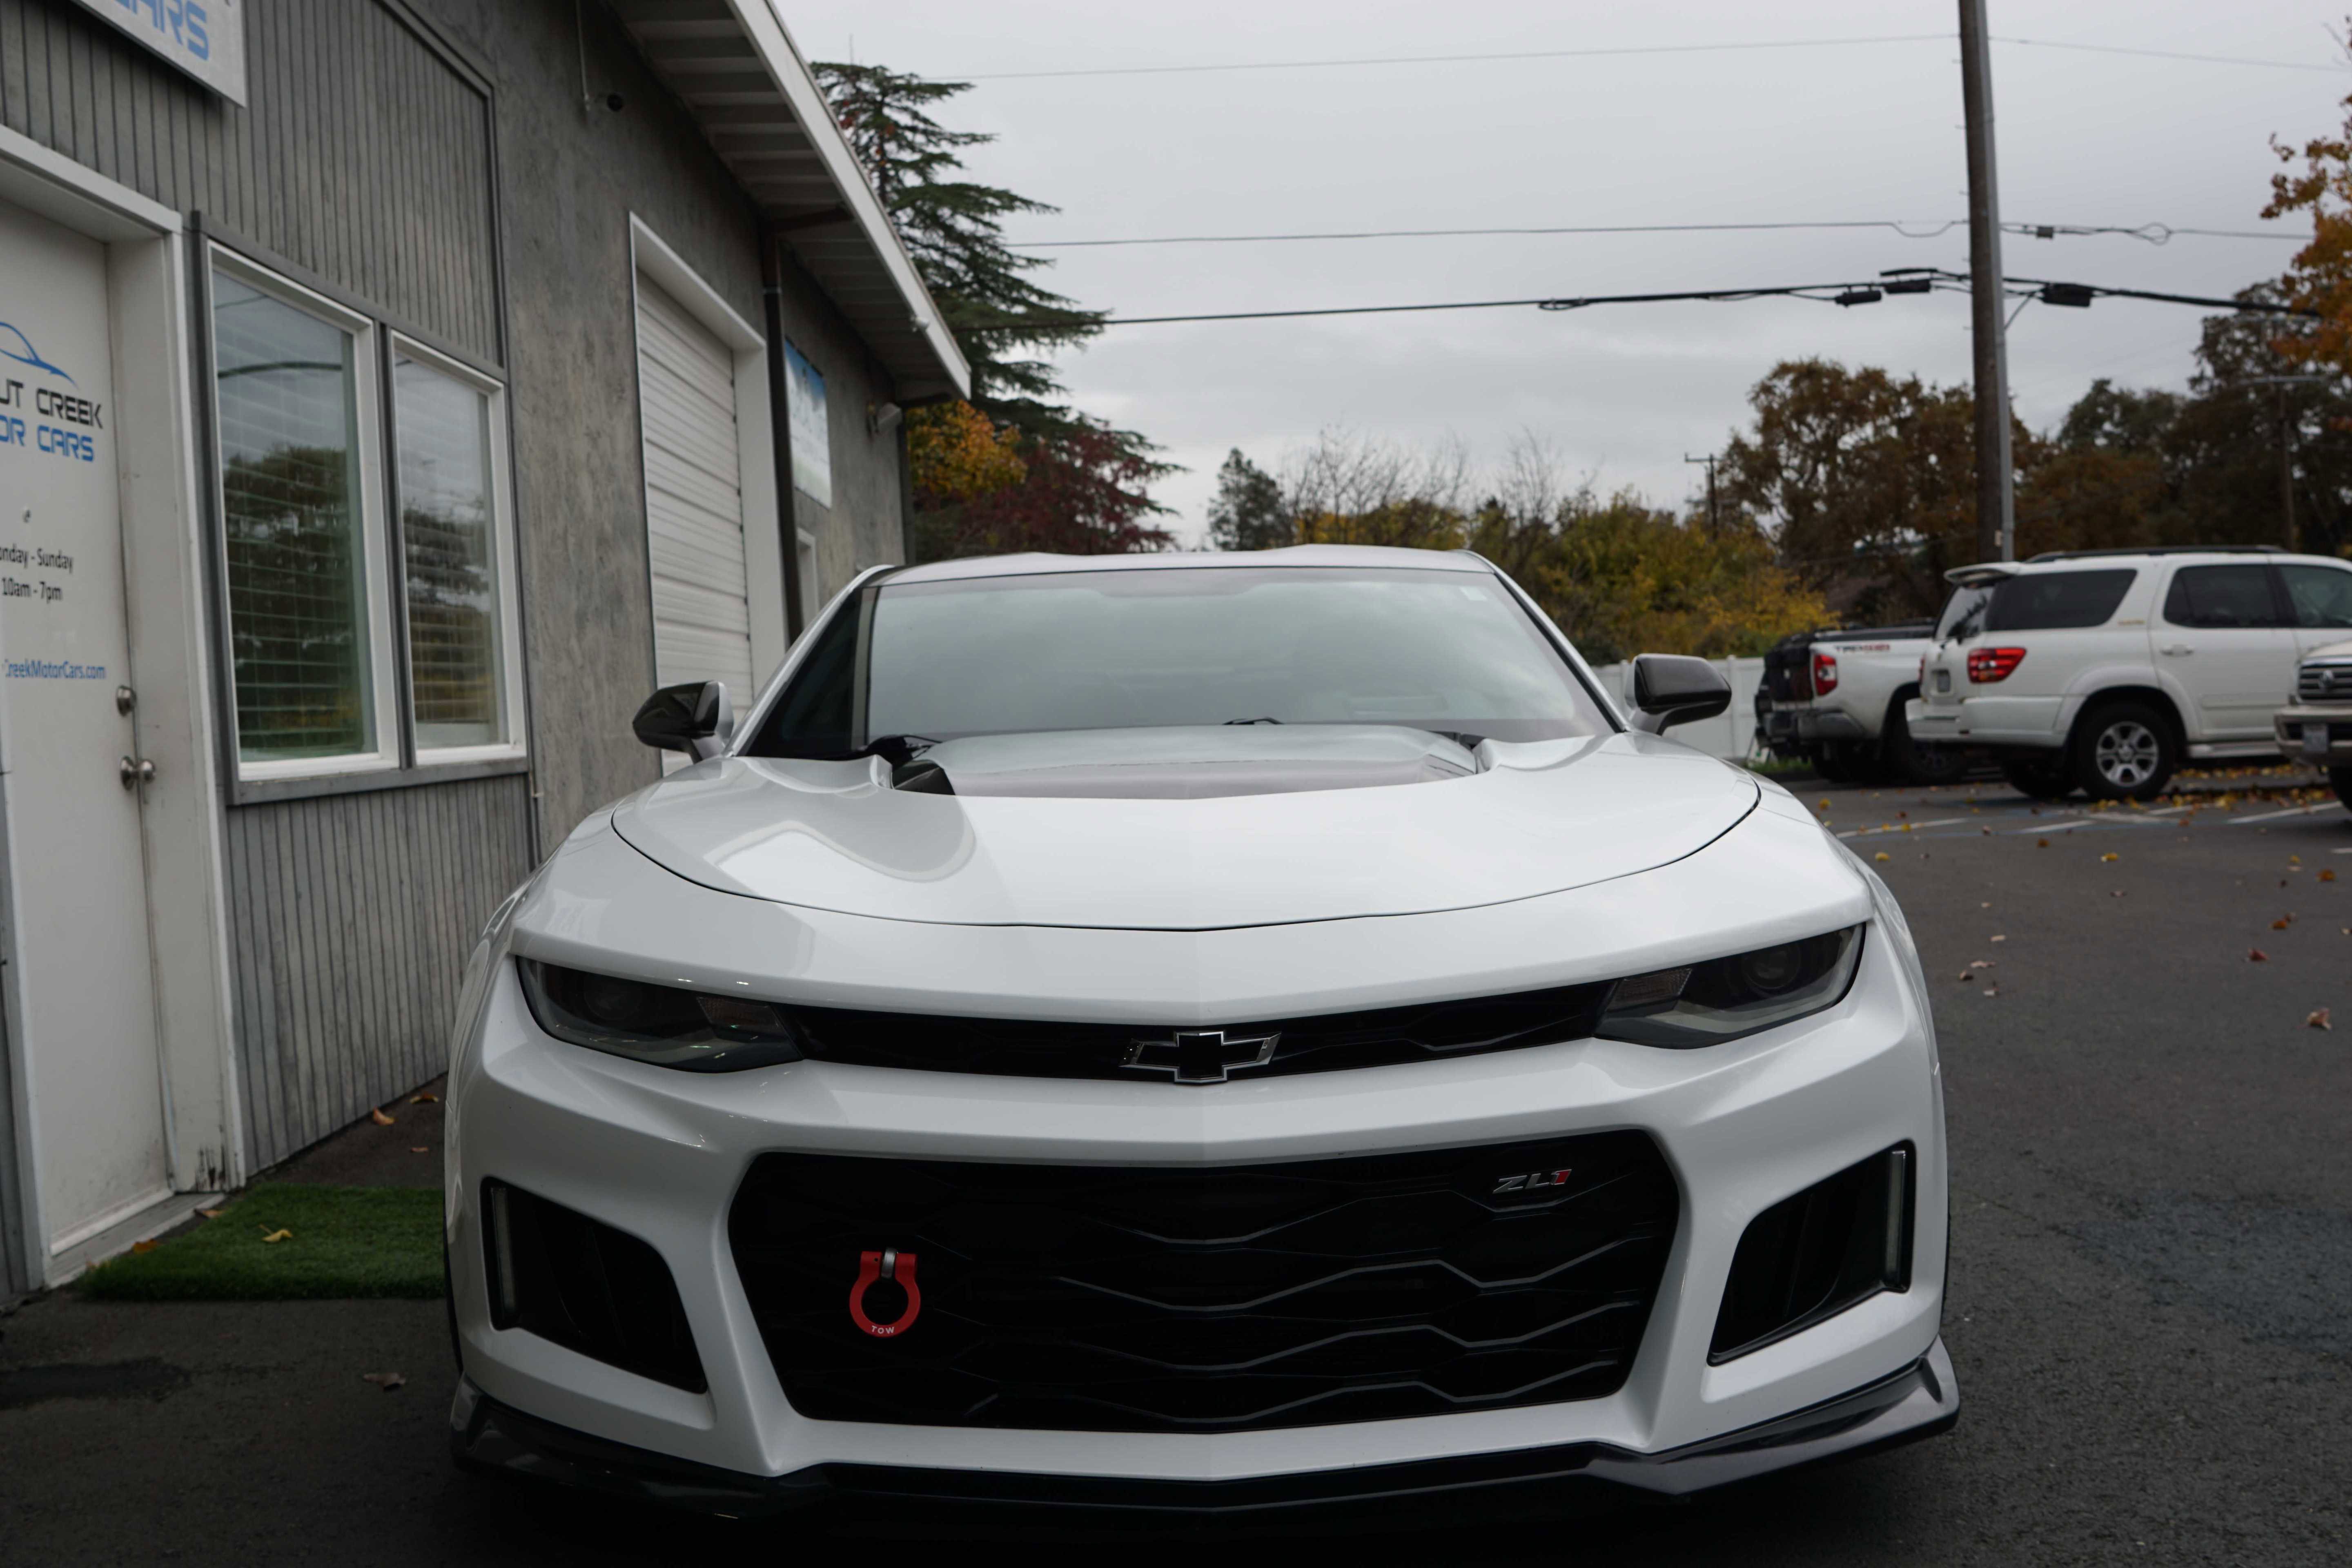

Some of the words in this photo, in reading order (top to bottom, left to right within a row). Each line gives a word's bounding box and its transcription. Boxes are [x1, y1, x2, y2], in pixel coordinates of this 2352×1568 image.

[36, 388, 103, 429] CREEK
[37, 425, 94, 462] CARS
[37, 548, 74, 574] Sunday
[2, 577, 31, 597] 10am
[39, 581, 62, 604] 7pm
[1492, 1169, 1572, 1194] ZL1
[871, 1325, 895, 1334] TOW
